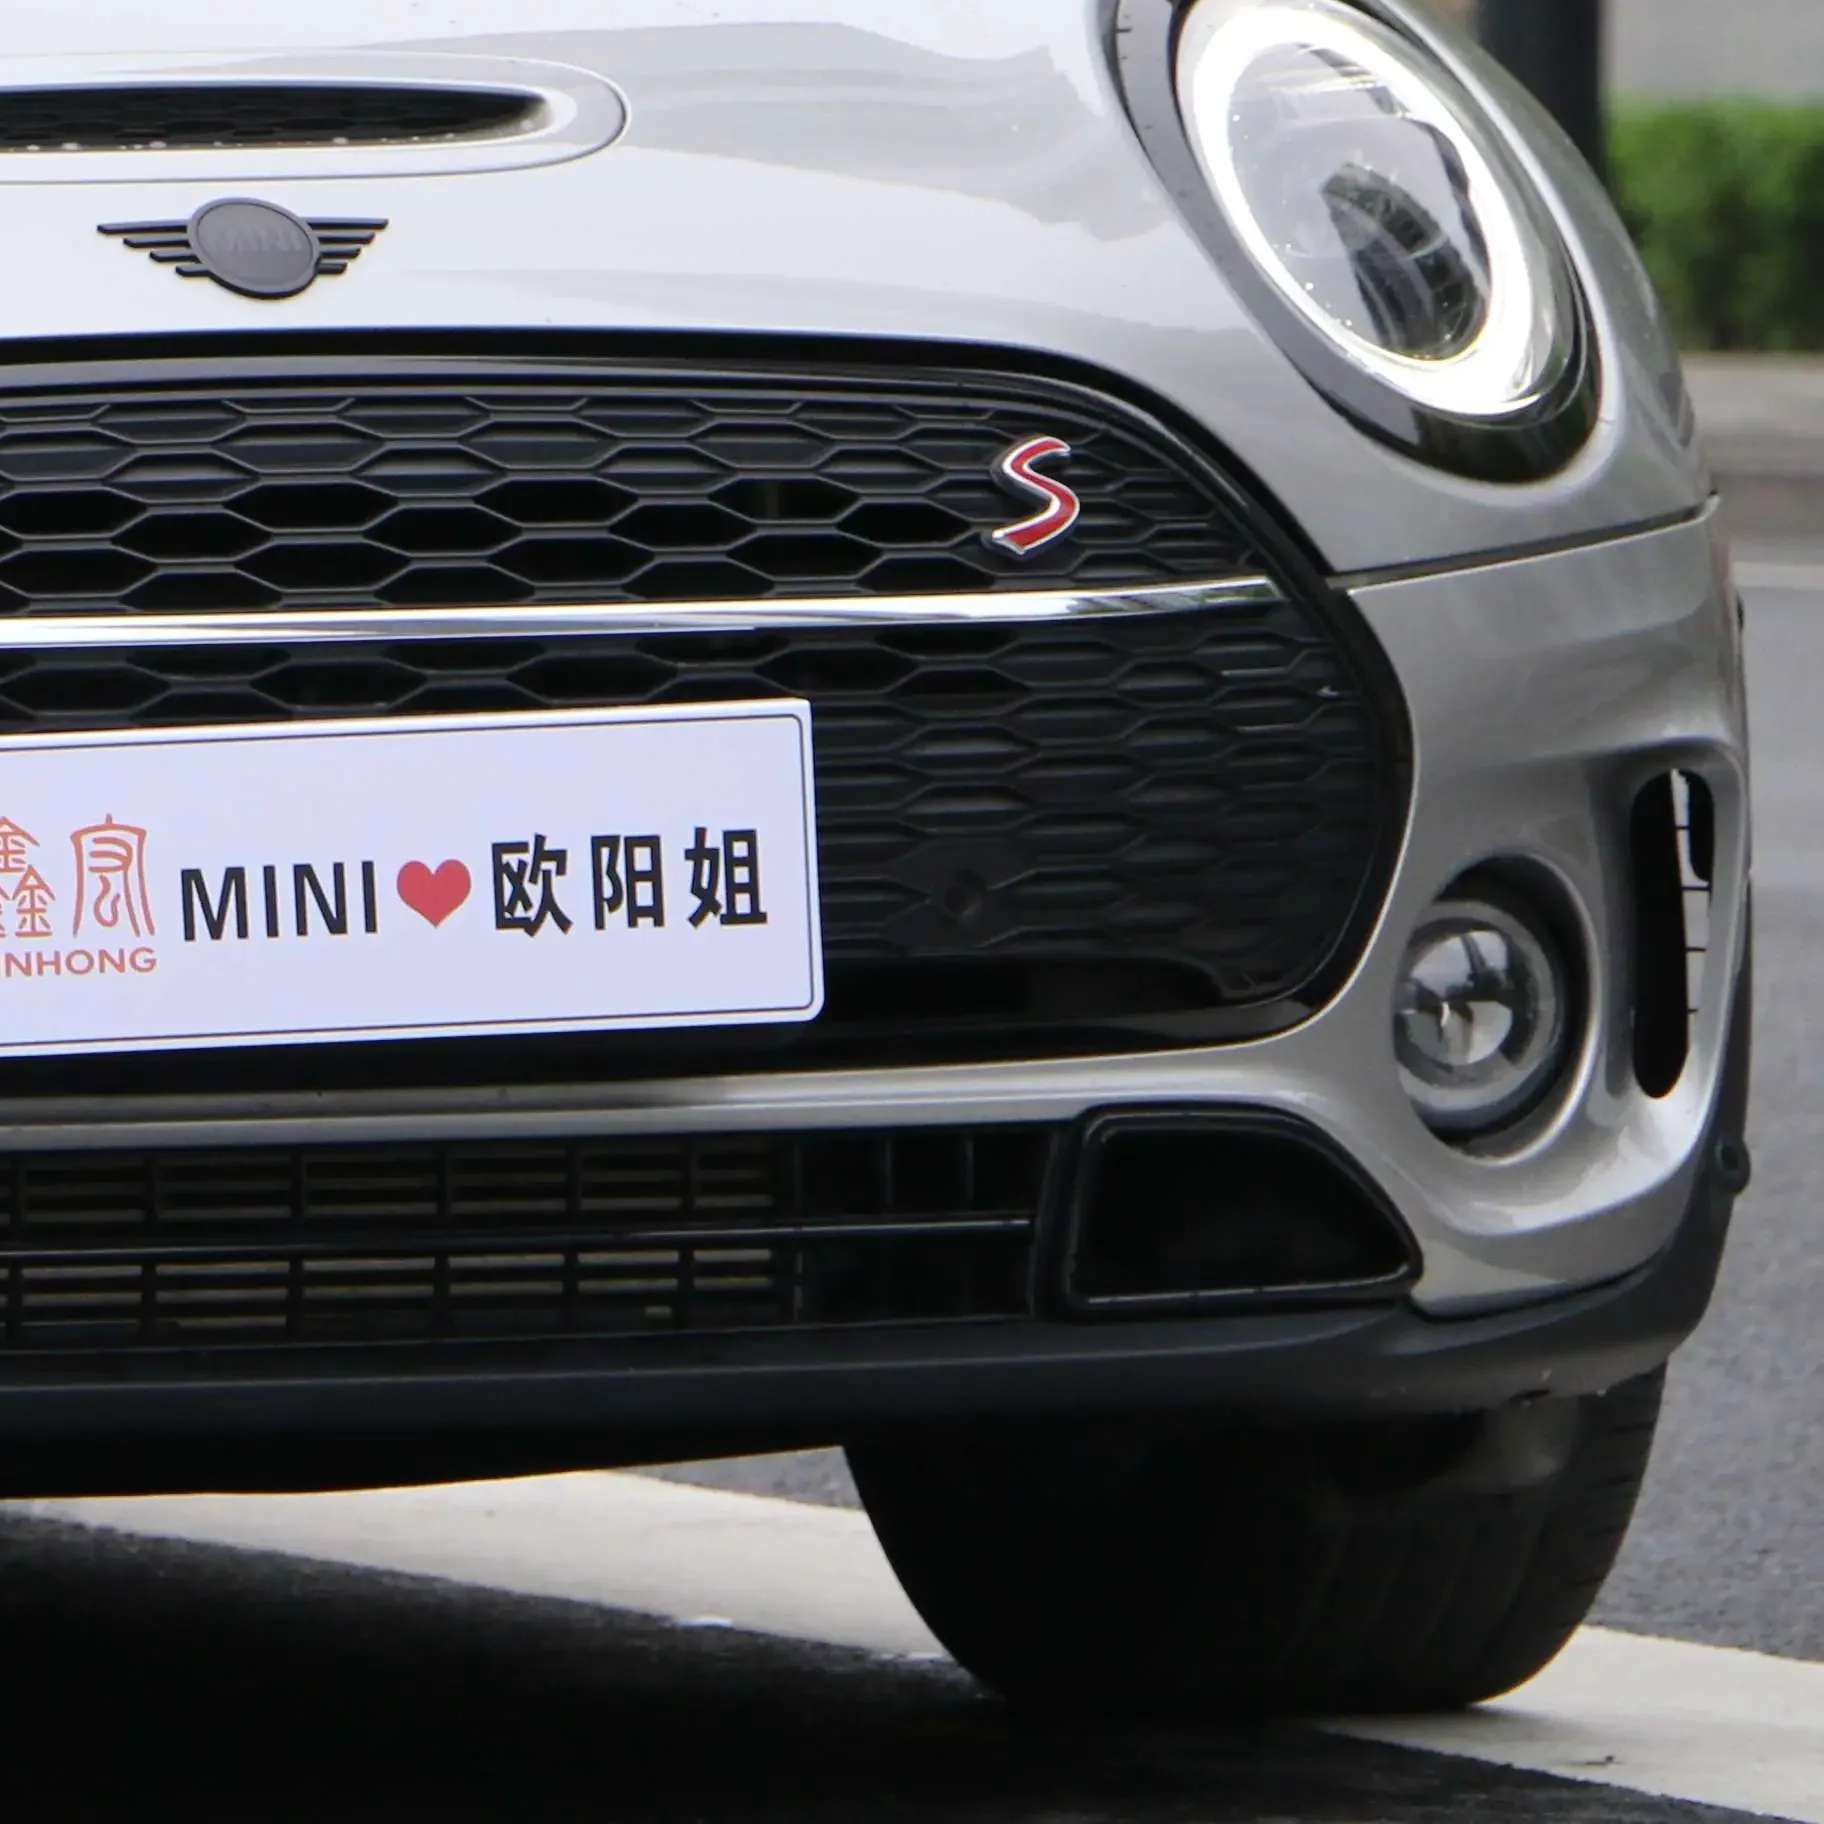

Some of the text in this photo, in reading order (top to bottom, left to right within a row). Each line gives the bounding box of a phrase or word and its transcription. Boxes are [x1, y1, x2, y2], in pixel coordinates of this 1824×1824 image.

[992, 436, 1080, 555] S
[180, 826, 768, 942] MINI 欧阳姐
